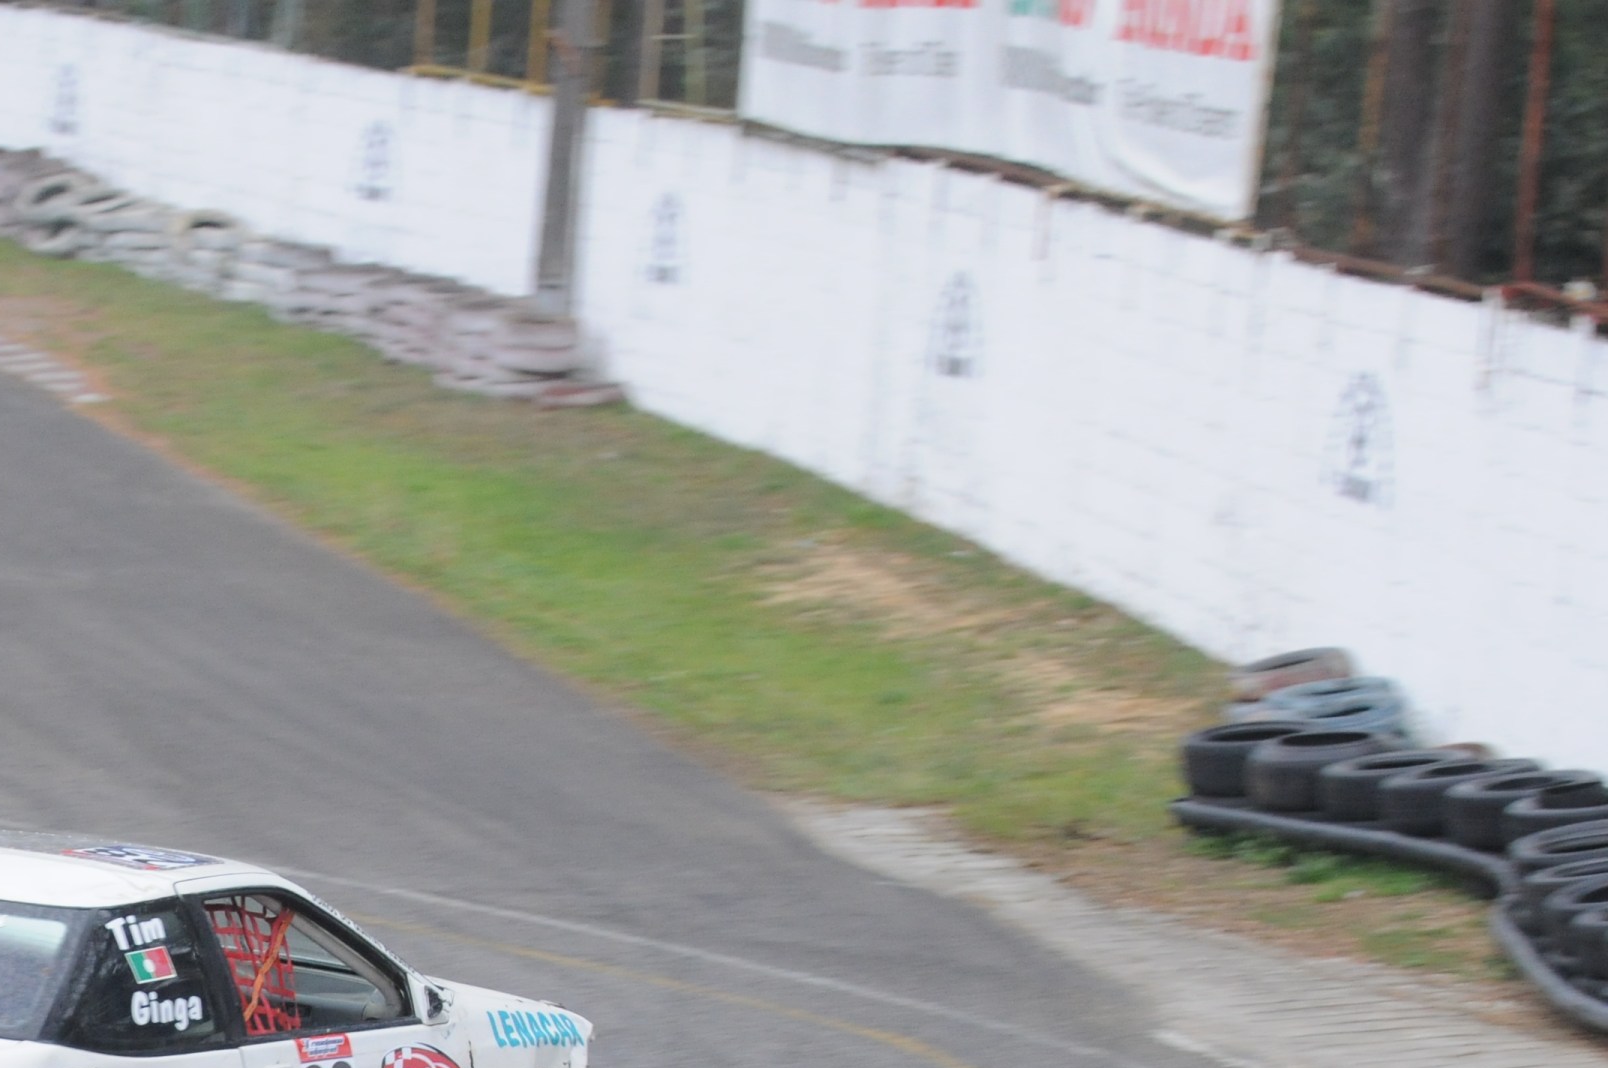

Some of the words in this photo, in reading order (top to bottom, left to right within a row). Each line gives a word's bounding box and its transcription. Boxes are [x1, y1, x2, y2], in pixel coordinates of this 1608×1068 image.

[105, 914, 166, 950] Tim
[131, 990, 203, 1031] Ginga
[486, 1010, 585, 1048] LENACAR
